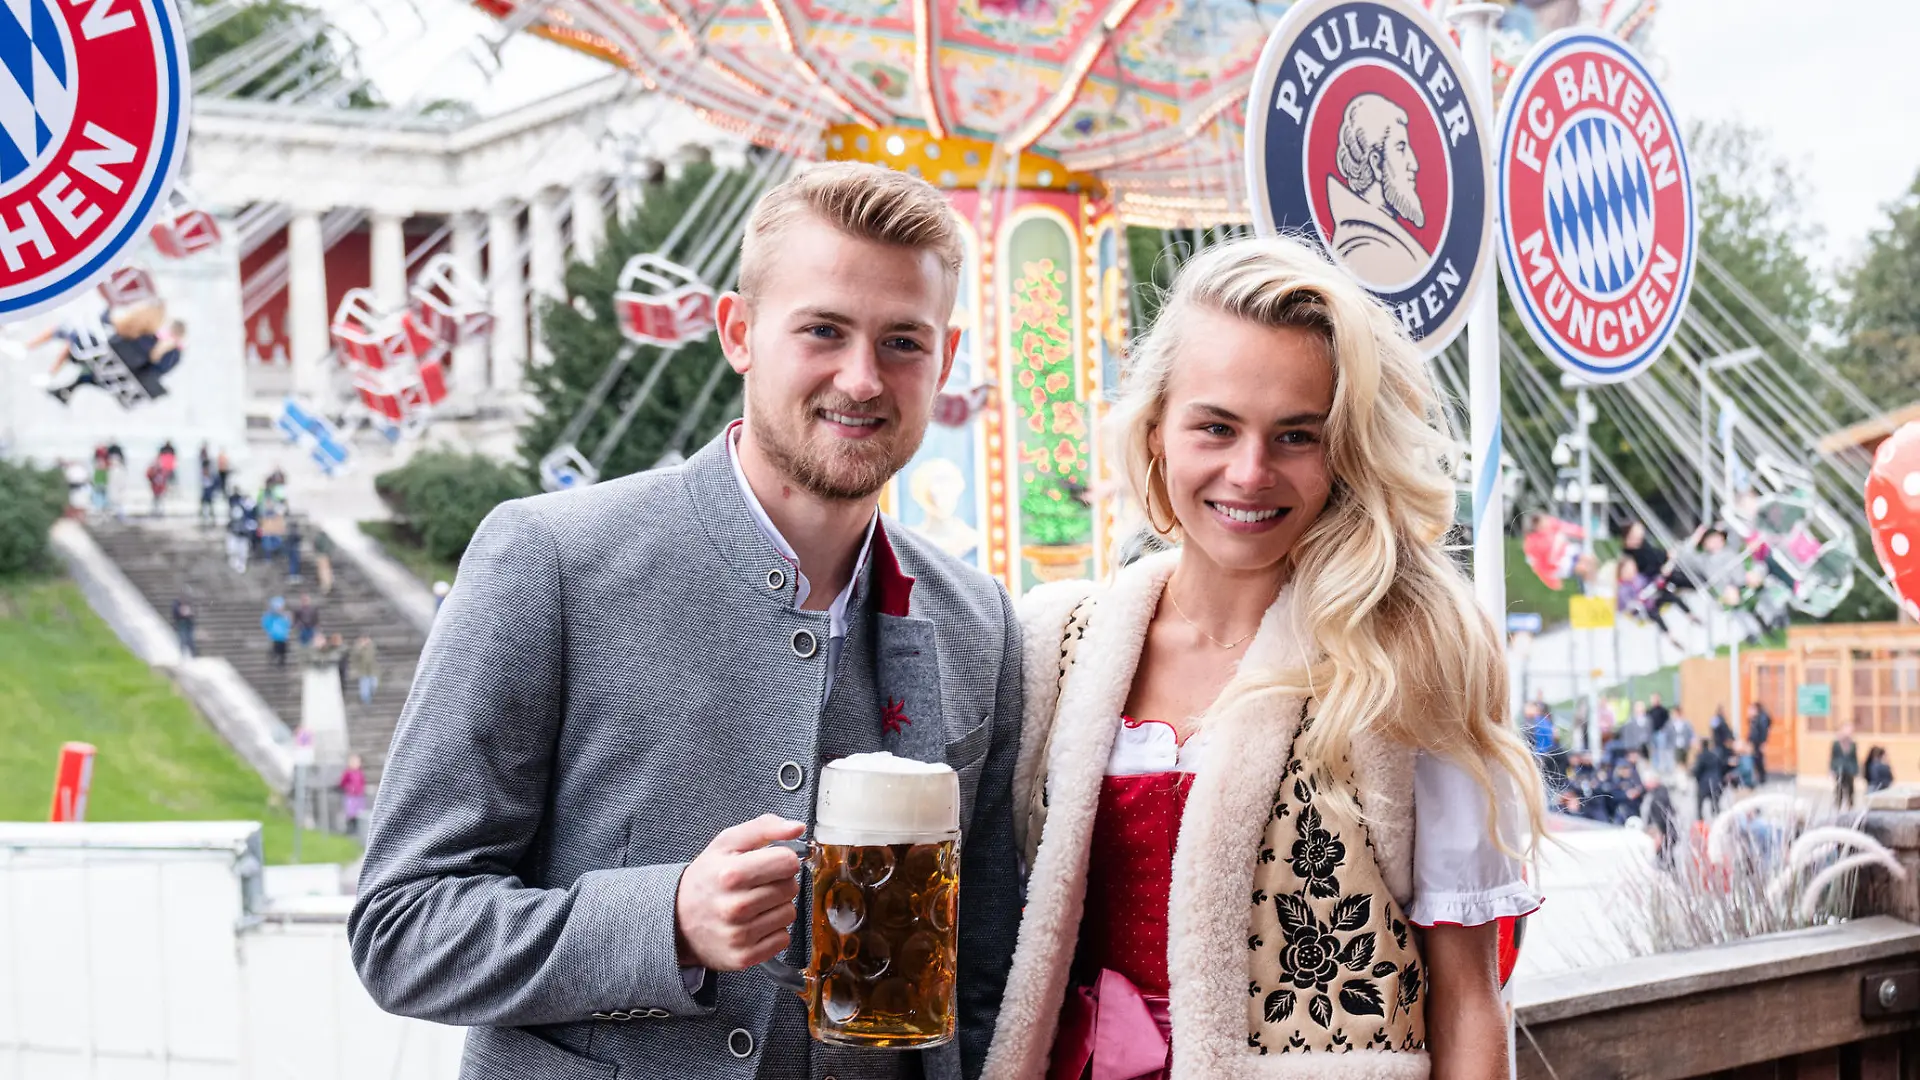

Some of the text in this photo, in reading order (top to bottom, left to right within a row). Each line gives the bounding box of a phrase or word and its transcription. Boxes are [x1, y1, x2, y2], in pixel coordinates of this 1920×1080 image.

[1276, 11, 1471, 148] PAULANER
[1516, 59, 1678, 191] FC BAYERN
[1519, 229, 1679, 352] MÜNCHEN
